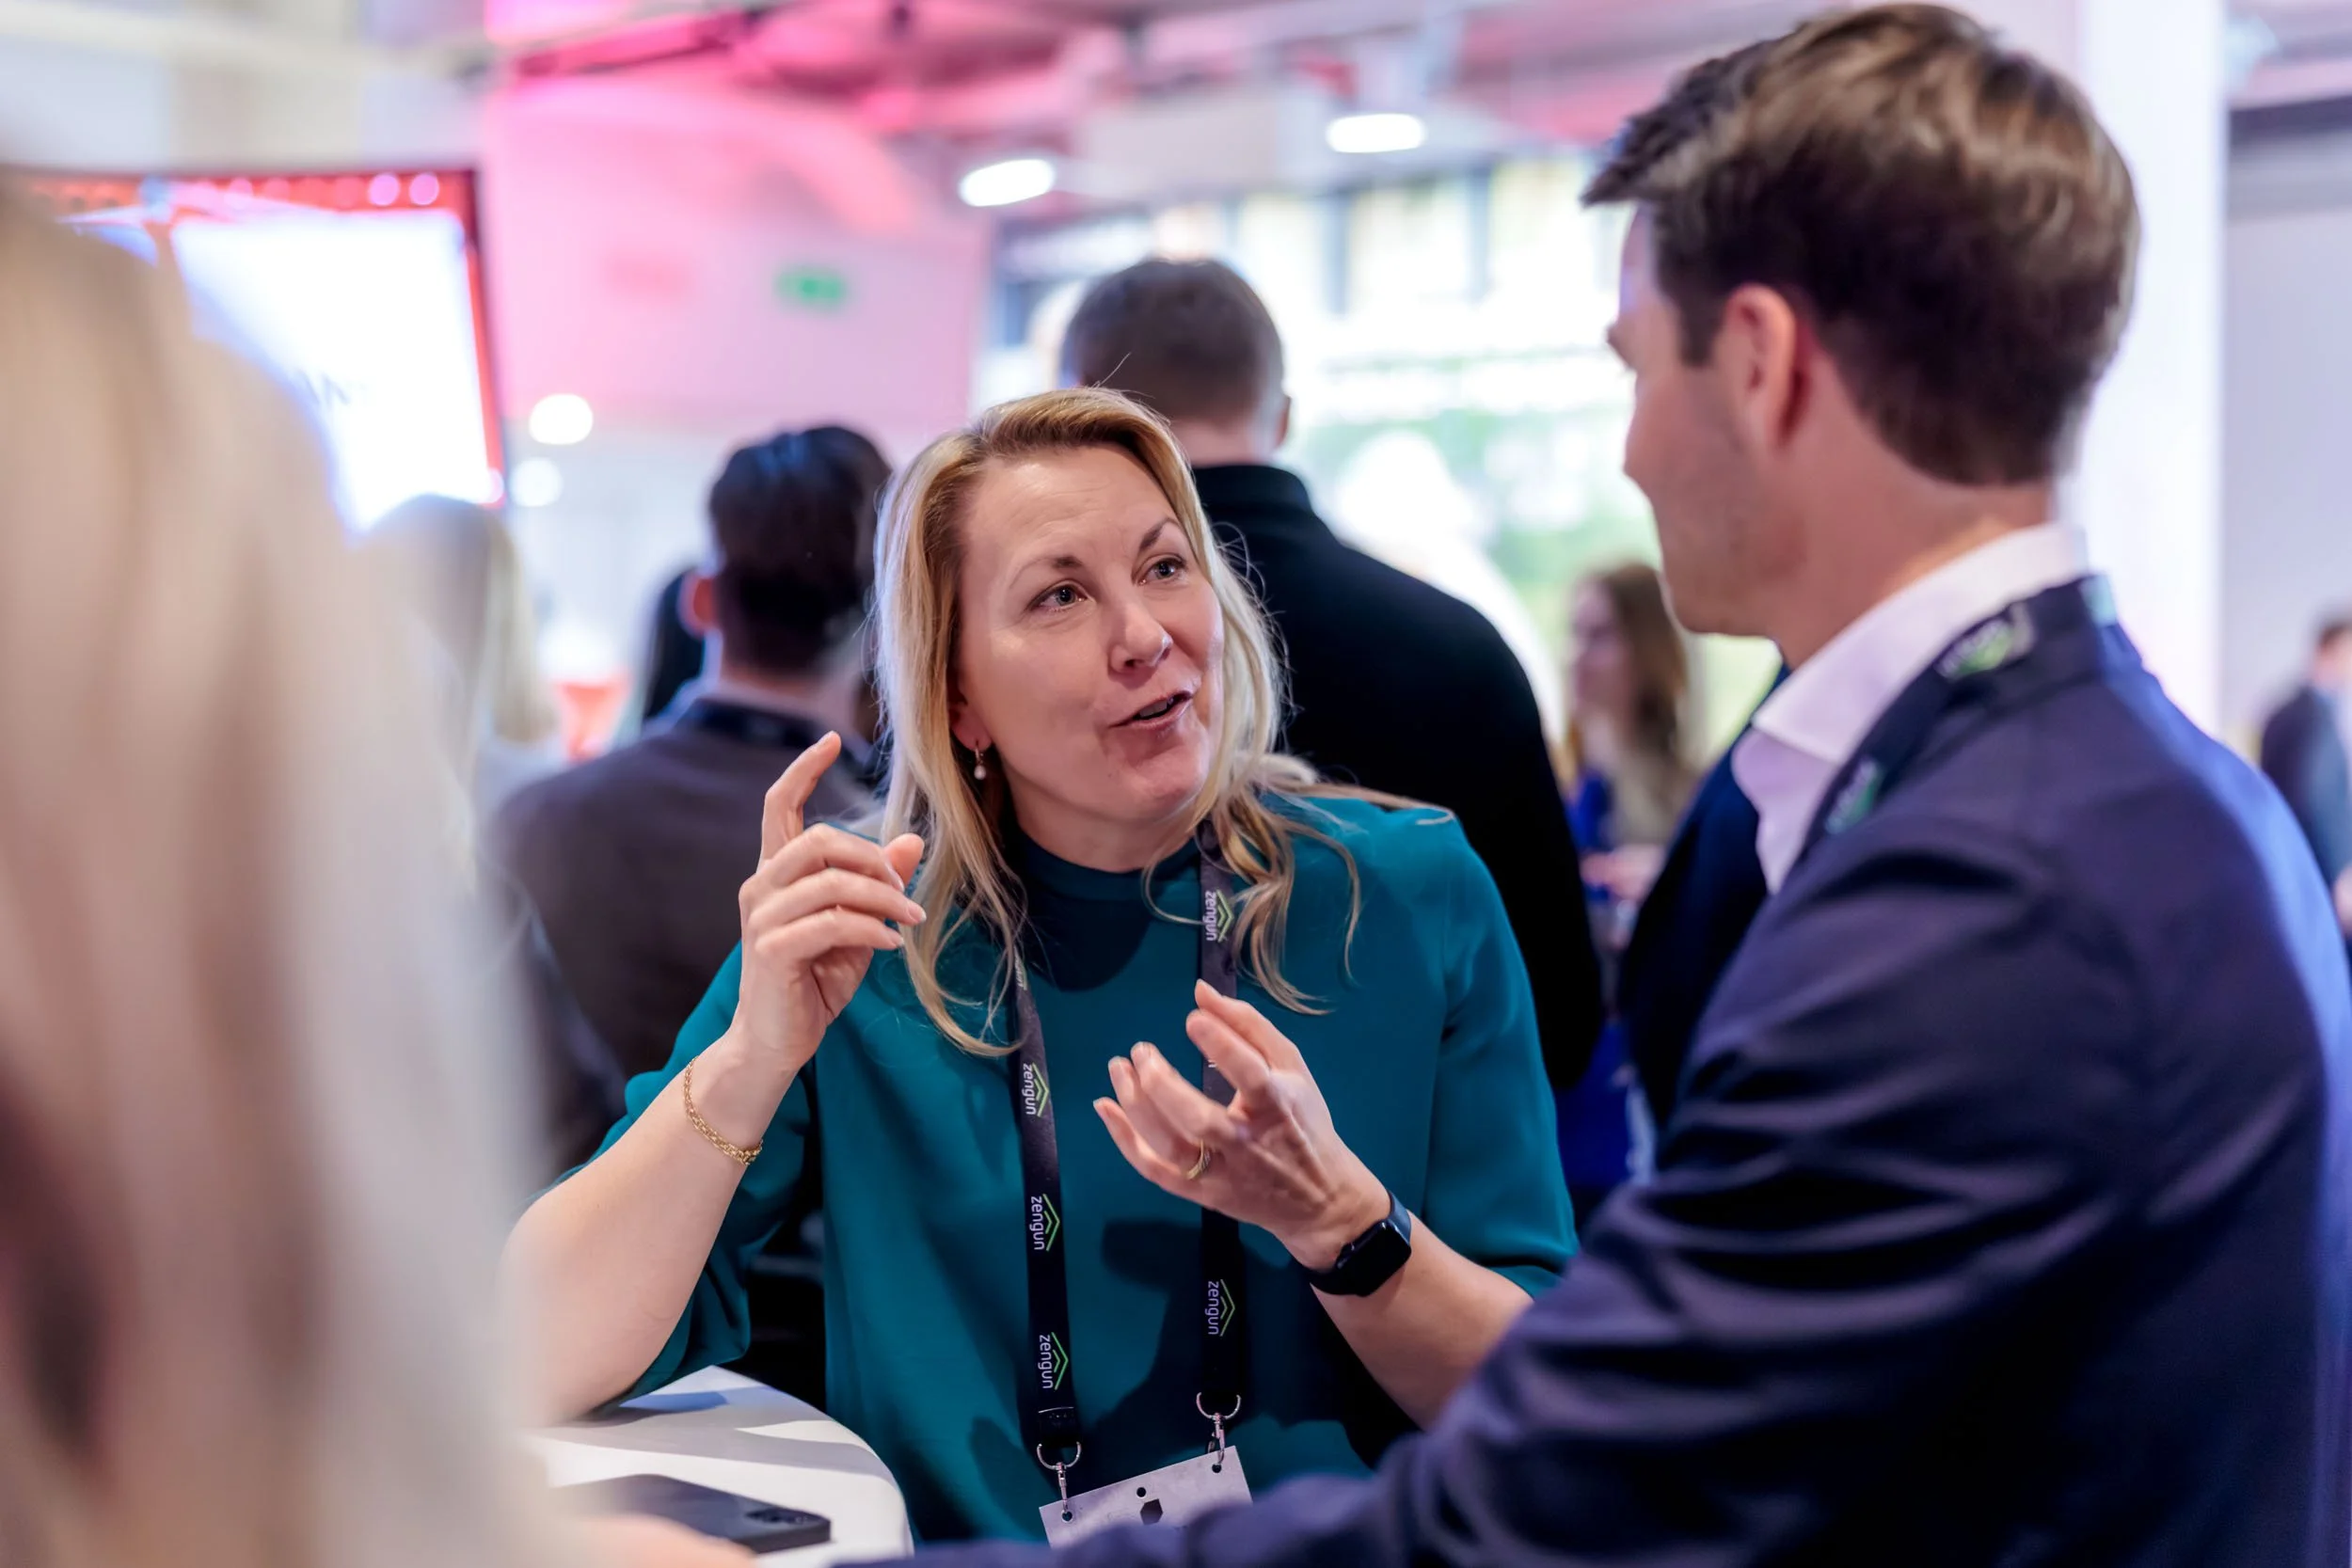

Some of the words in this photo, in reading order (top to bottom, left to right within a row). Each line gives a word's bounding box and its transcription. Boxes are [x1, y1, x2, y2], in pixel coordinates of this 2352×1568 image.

[1202, 890, 1217, 942] zengun
[1021, 1063, 1037, 1115] zengun
[1028, 1196, 1045, 1250] zengun
[1204, 1280, 1219, 1335] zengun
[1037, 1334, 1054, 1389] zengun
